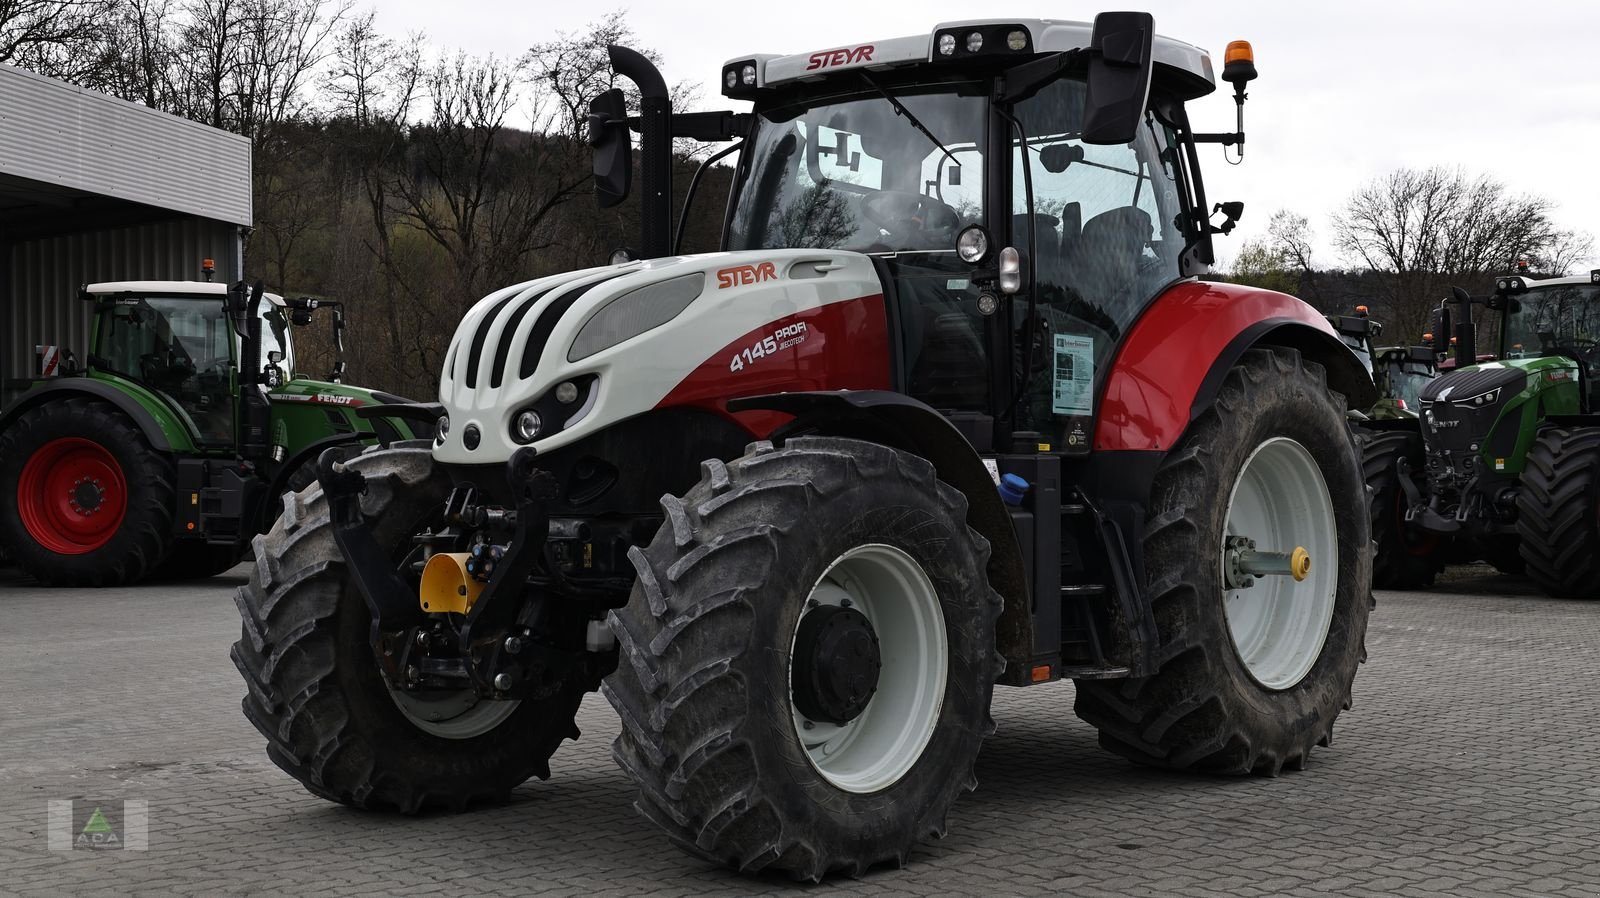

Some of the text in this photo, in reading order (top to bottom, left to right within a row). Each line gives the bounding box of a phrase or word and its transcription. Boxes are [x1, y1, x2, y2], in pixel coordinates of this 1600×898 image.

[806, 45, 875, 70] STEYR
[717, 262, 777, 289] STEYR
[730, 321, 807, 372] 4145 PROFI
[317, 394, 354, 405] FENDT
